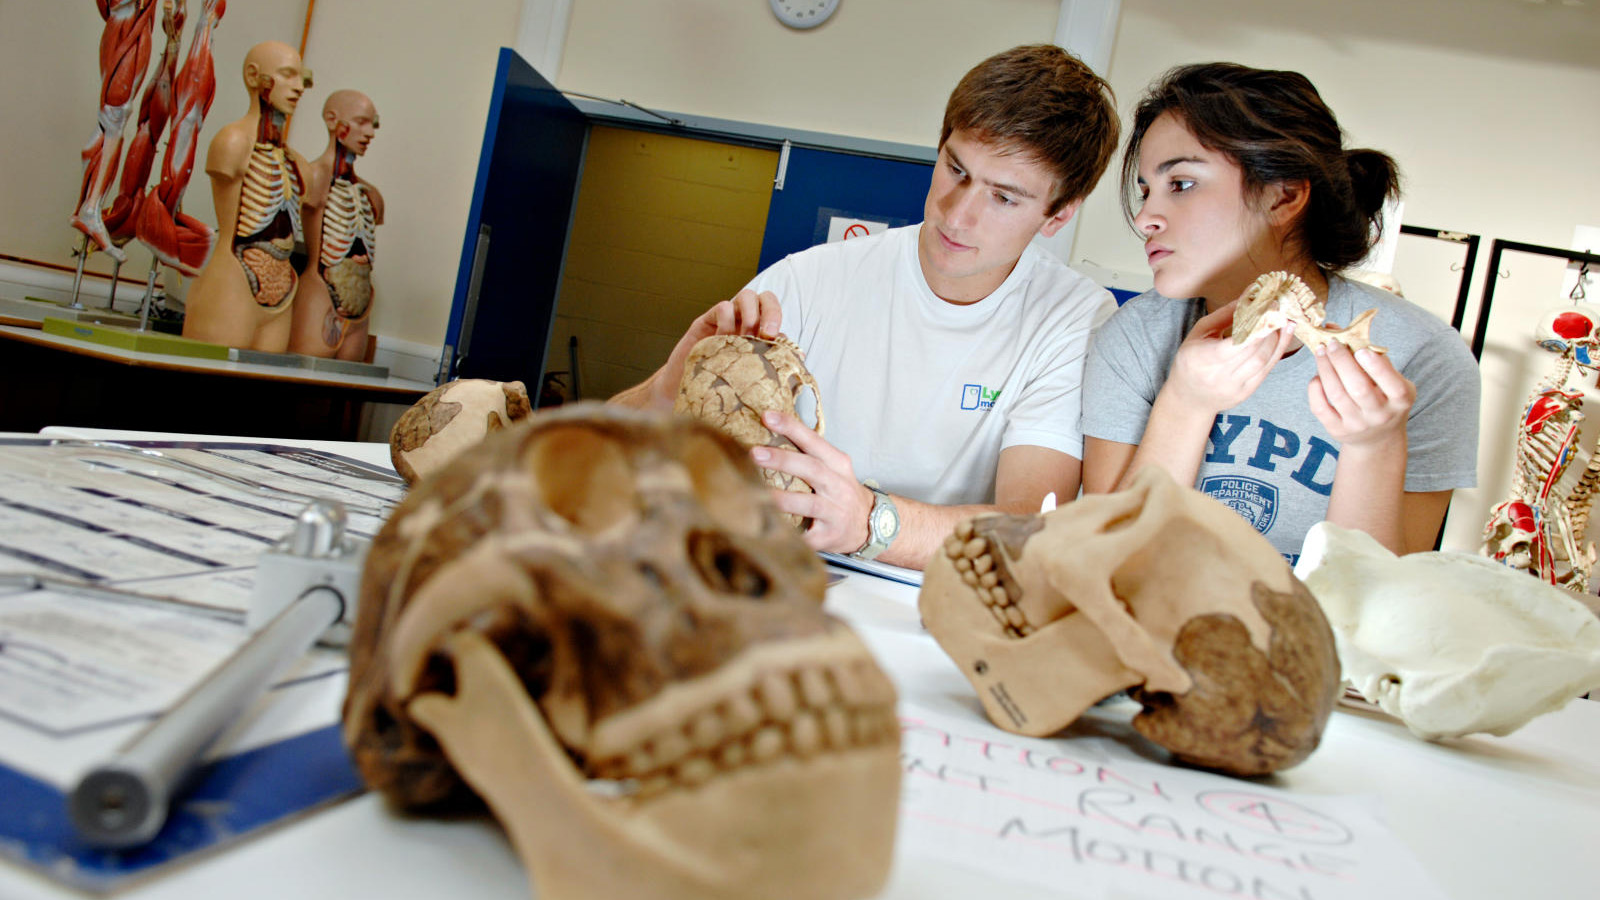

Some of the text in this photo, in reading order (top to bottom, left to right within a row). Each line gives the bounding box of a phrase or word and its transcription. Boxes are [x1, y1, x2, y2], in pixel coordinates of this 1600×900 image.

[982, 386, 1001, 401] Ly
[1205, 414, 1340, 496] YPD
[1220, 480, 1260, 494] POLICE
